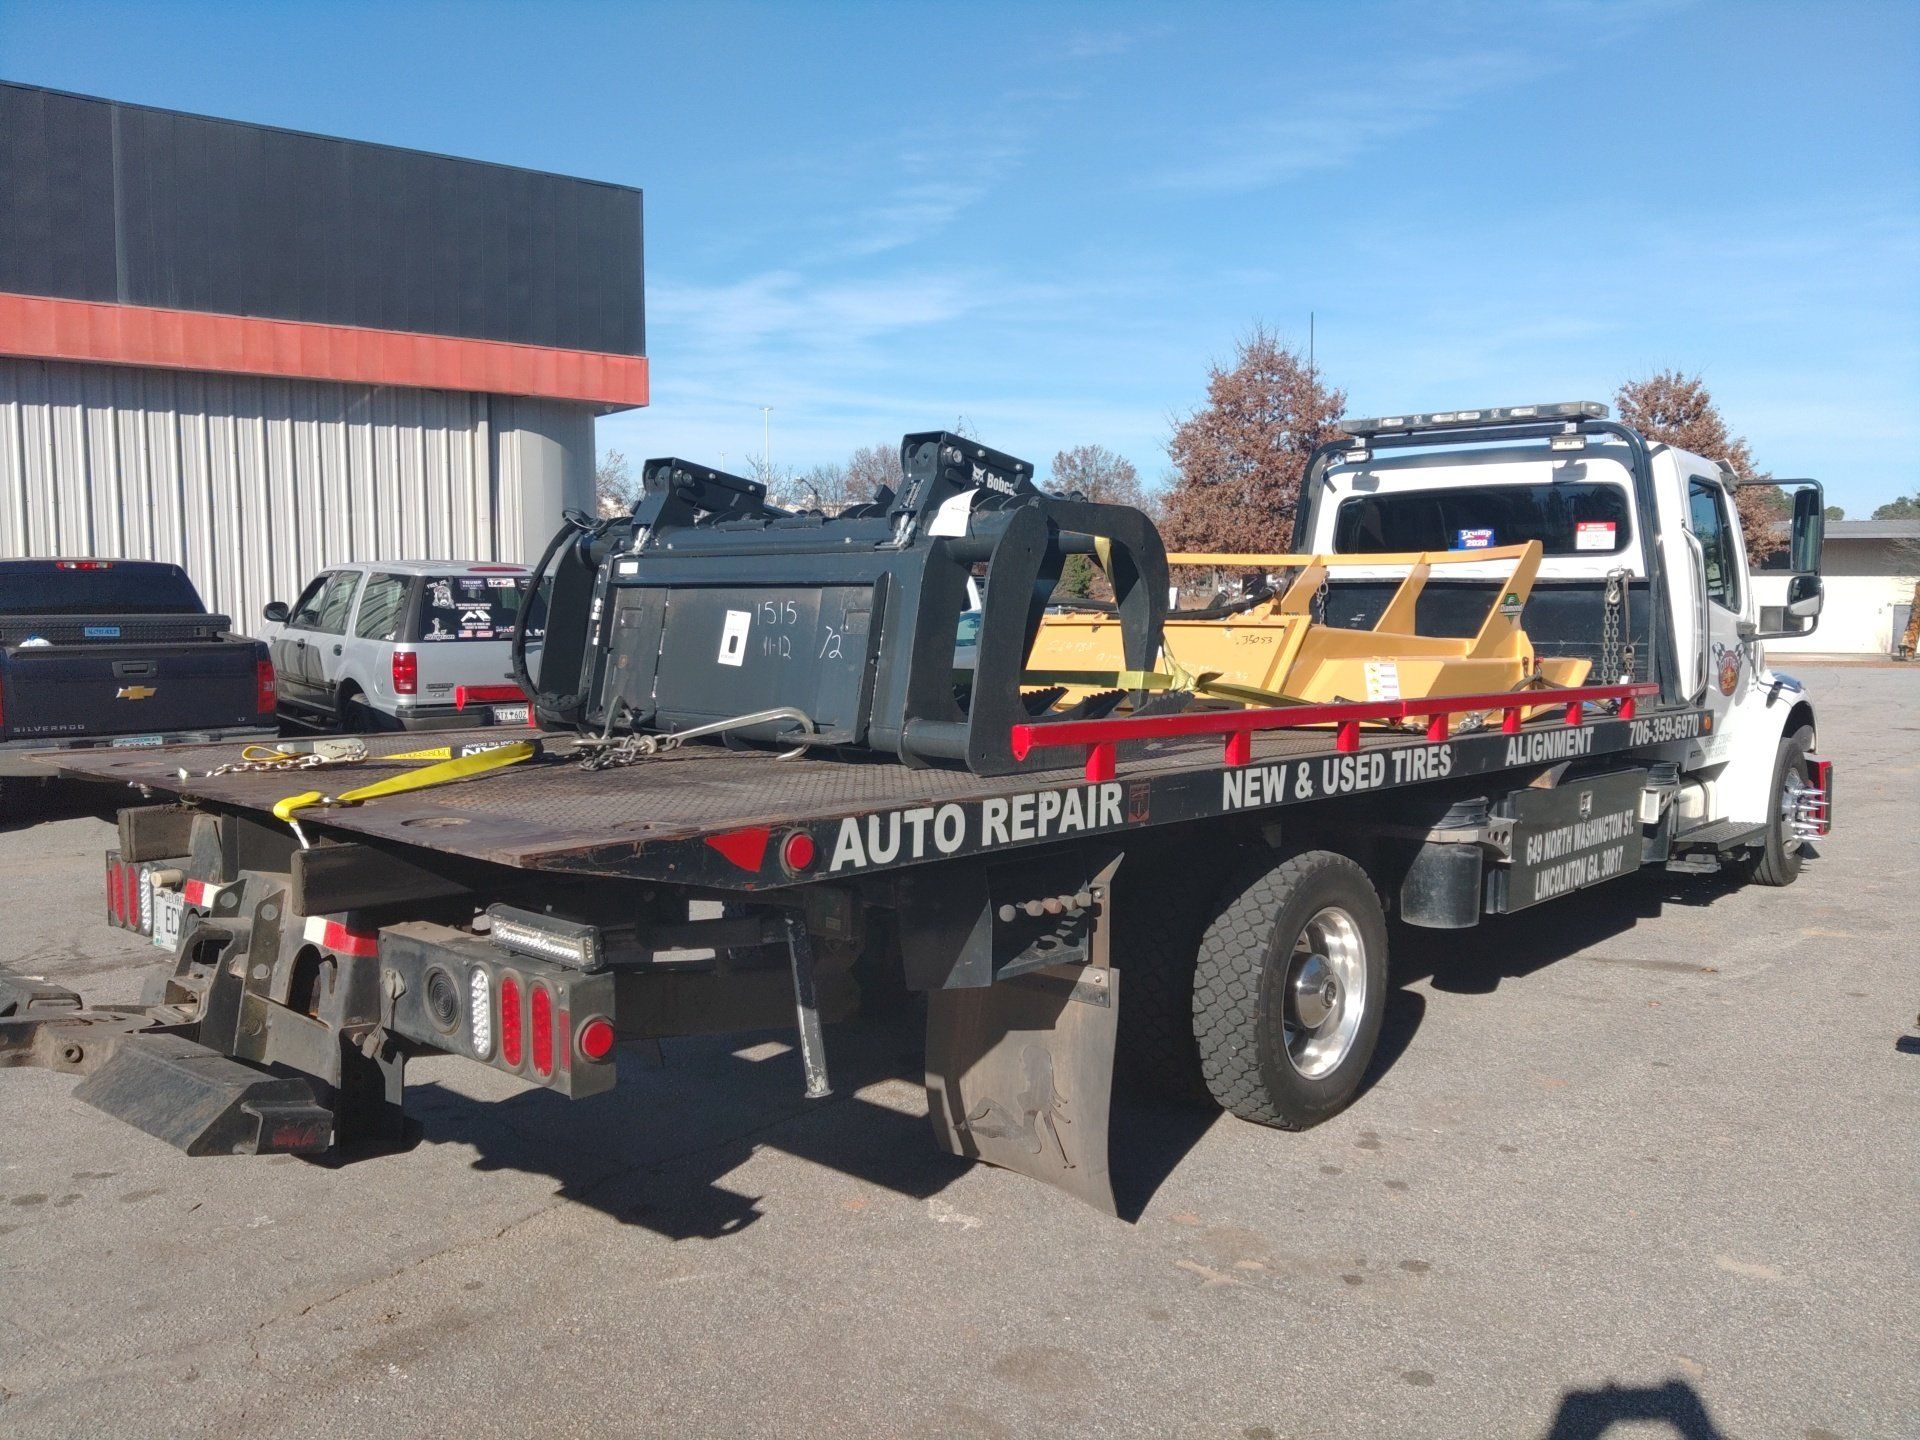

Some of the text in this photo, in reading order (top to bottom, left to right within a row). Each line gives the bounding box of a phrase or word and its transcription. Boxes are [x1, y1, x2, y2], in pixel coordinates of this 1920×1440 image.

[1466, 539, 1488, 547] 2020
[756, 600, 797, 626] 1515
[819, 625, 843, 660] 72
[13, 724, 85, 733] SILVERADO
[514, 710, 527, 719] 602
[1629, 713, 1699, 746] 706-359-6970
[1505, 727, 1594, 766] ALIGNMENT
[1222, 744, 1452, 810] NEW & USED TIRES
[829, 782, 1123, 872] AUTO REPAIR
[1526, 809, 1634, 866] 649 NORTH WASHINGTON ST.
[1535, 845, 1624, 901] LINCOLNTON GA. 30817
